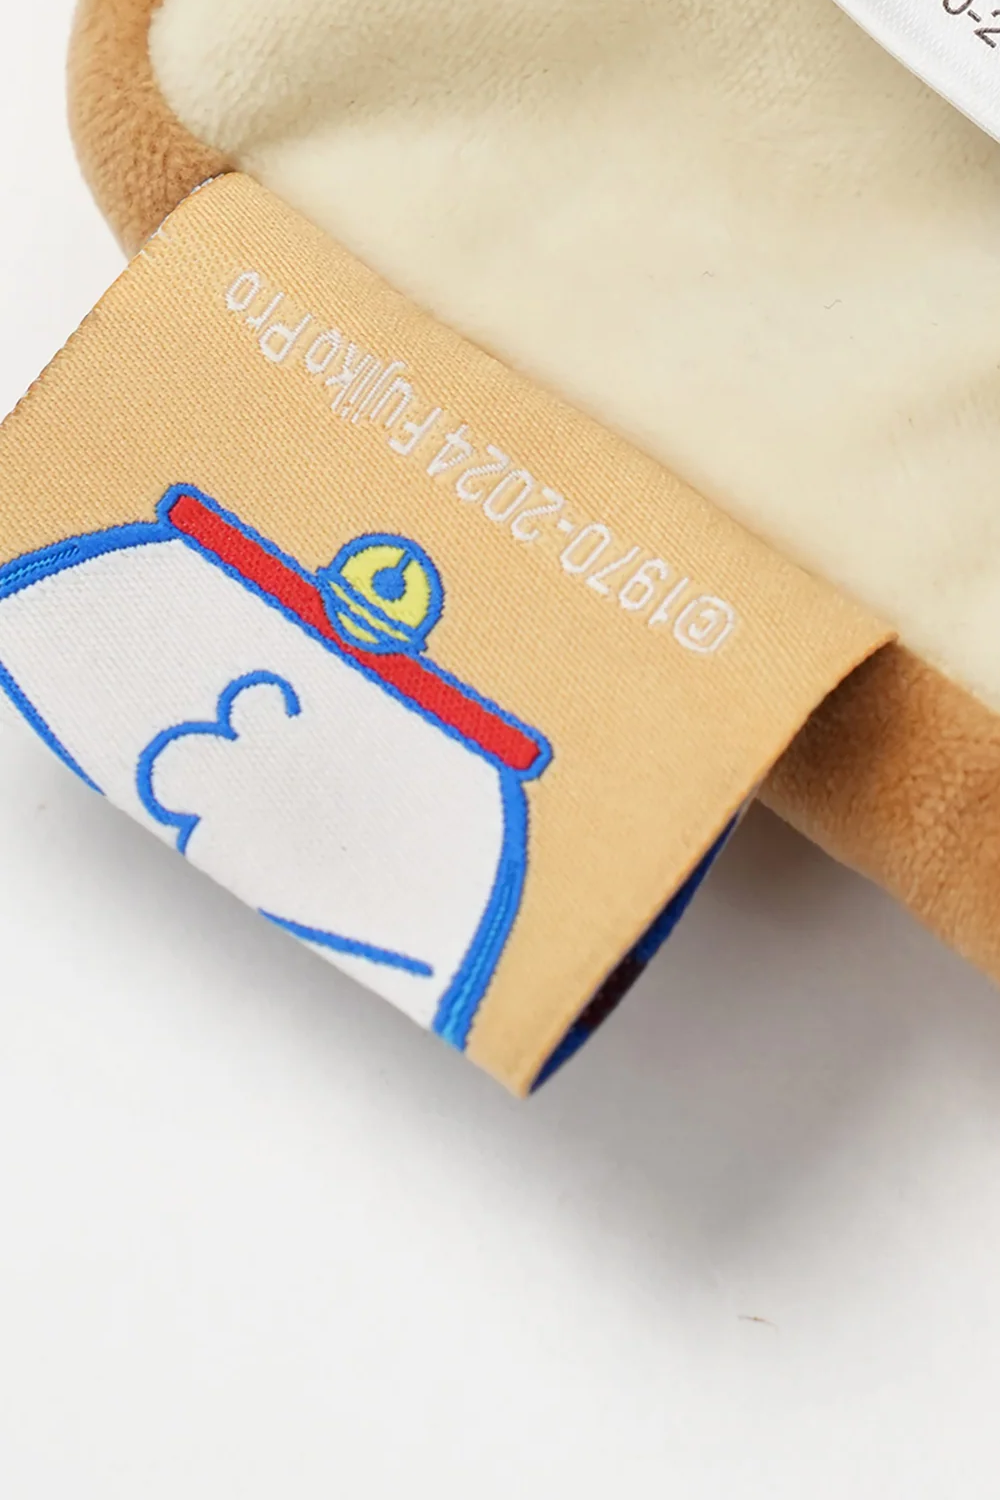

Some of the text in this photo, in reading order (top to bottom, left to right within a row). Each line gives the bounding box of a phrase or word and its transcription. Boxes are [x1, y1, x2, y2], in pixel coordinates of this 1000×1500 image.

[225, 271, 735, 652] ©1970-2024 Fujiko Pro
